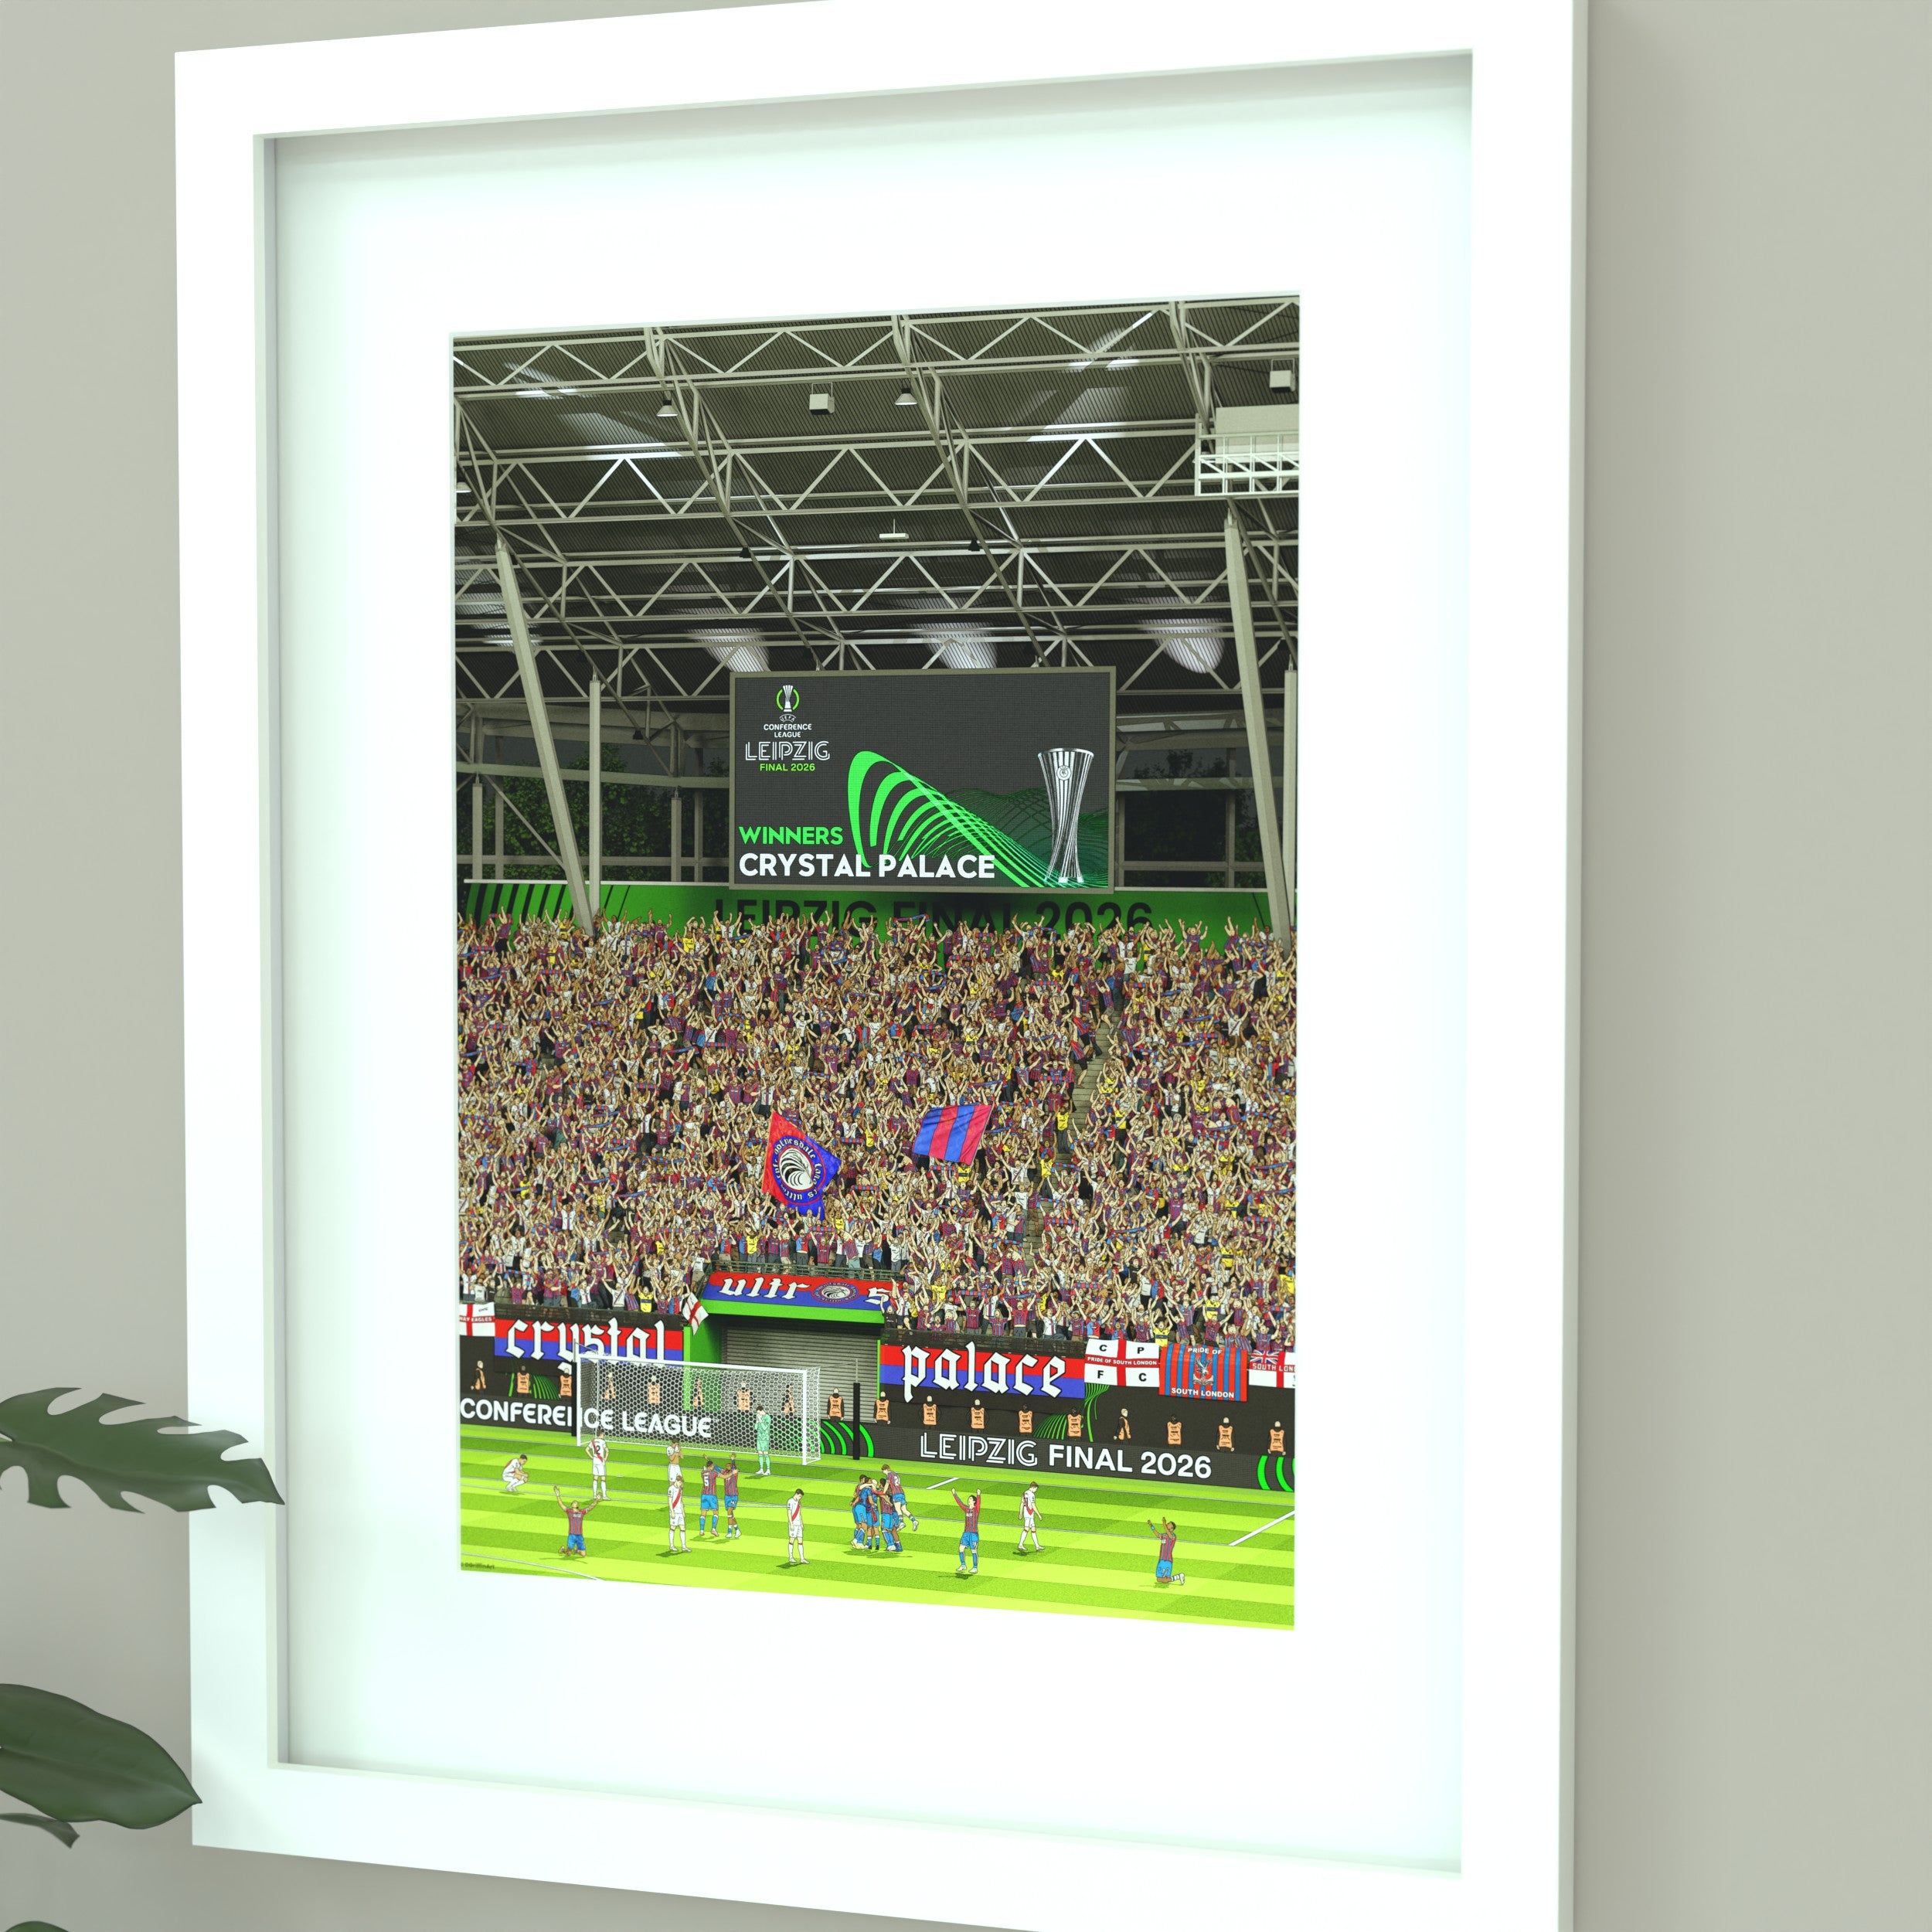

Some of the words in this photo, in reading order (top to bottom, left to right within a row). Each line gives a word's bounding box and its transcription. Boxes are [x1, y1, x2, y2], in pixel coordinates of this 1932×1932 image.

[745, 741, 831, 761] LEIPZIG
[760, 763, 788, 771] FINAL
[791, 763, 815, 771] 2026
[739, 826, 844, 845] WINNERS
[739, 852, 871, 877] CRYSTAL
[879, 854, 995, 879] PALACE
[505, 1317, 666, 1375] crystal
[902, 1341, 1066, 1403] palace
[1097, 1370, 1104, 1379] F
[1138, 1372, 1147, 1382] C
[1252, 1362, 1277, 1371] SOUTH
[1171, 1387, 1199, 1396] SOUTH
[622, 1410, 713, 1438] LEAGUE
[920, 1432, 1038, 1467] LEIPZIG
[1049, 1444, 1133, 1473] FINAL
[1140, 1451, 1213, 1479] 2026
